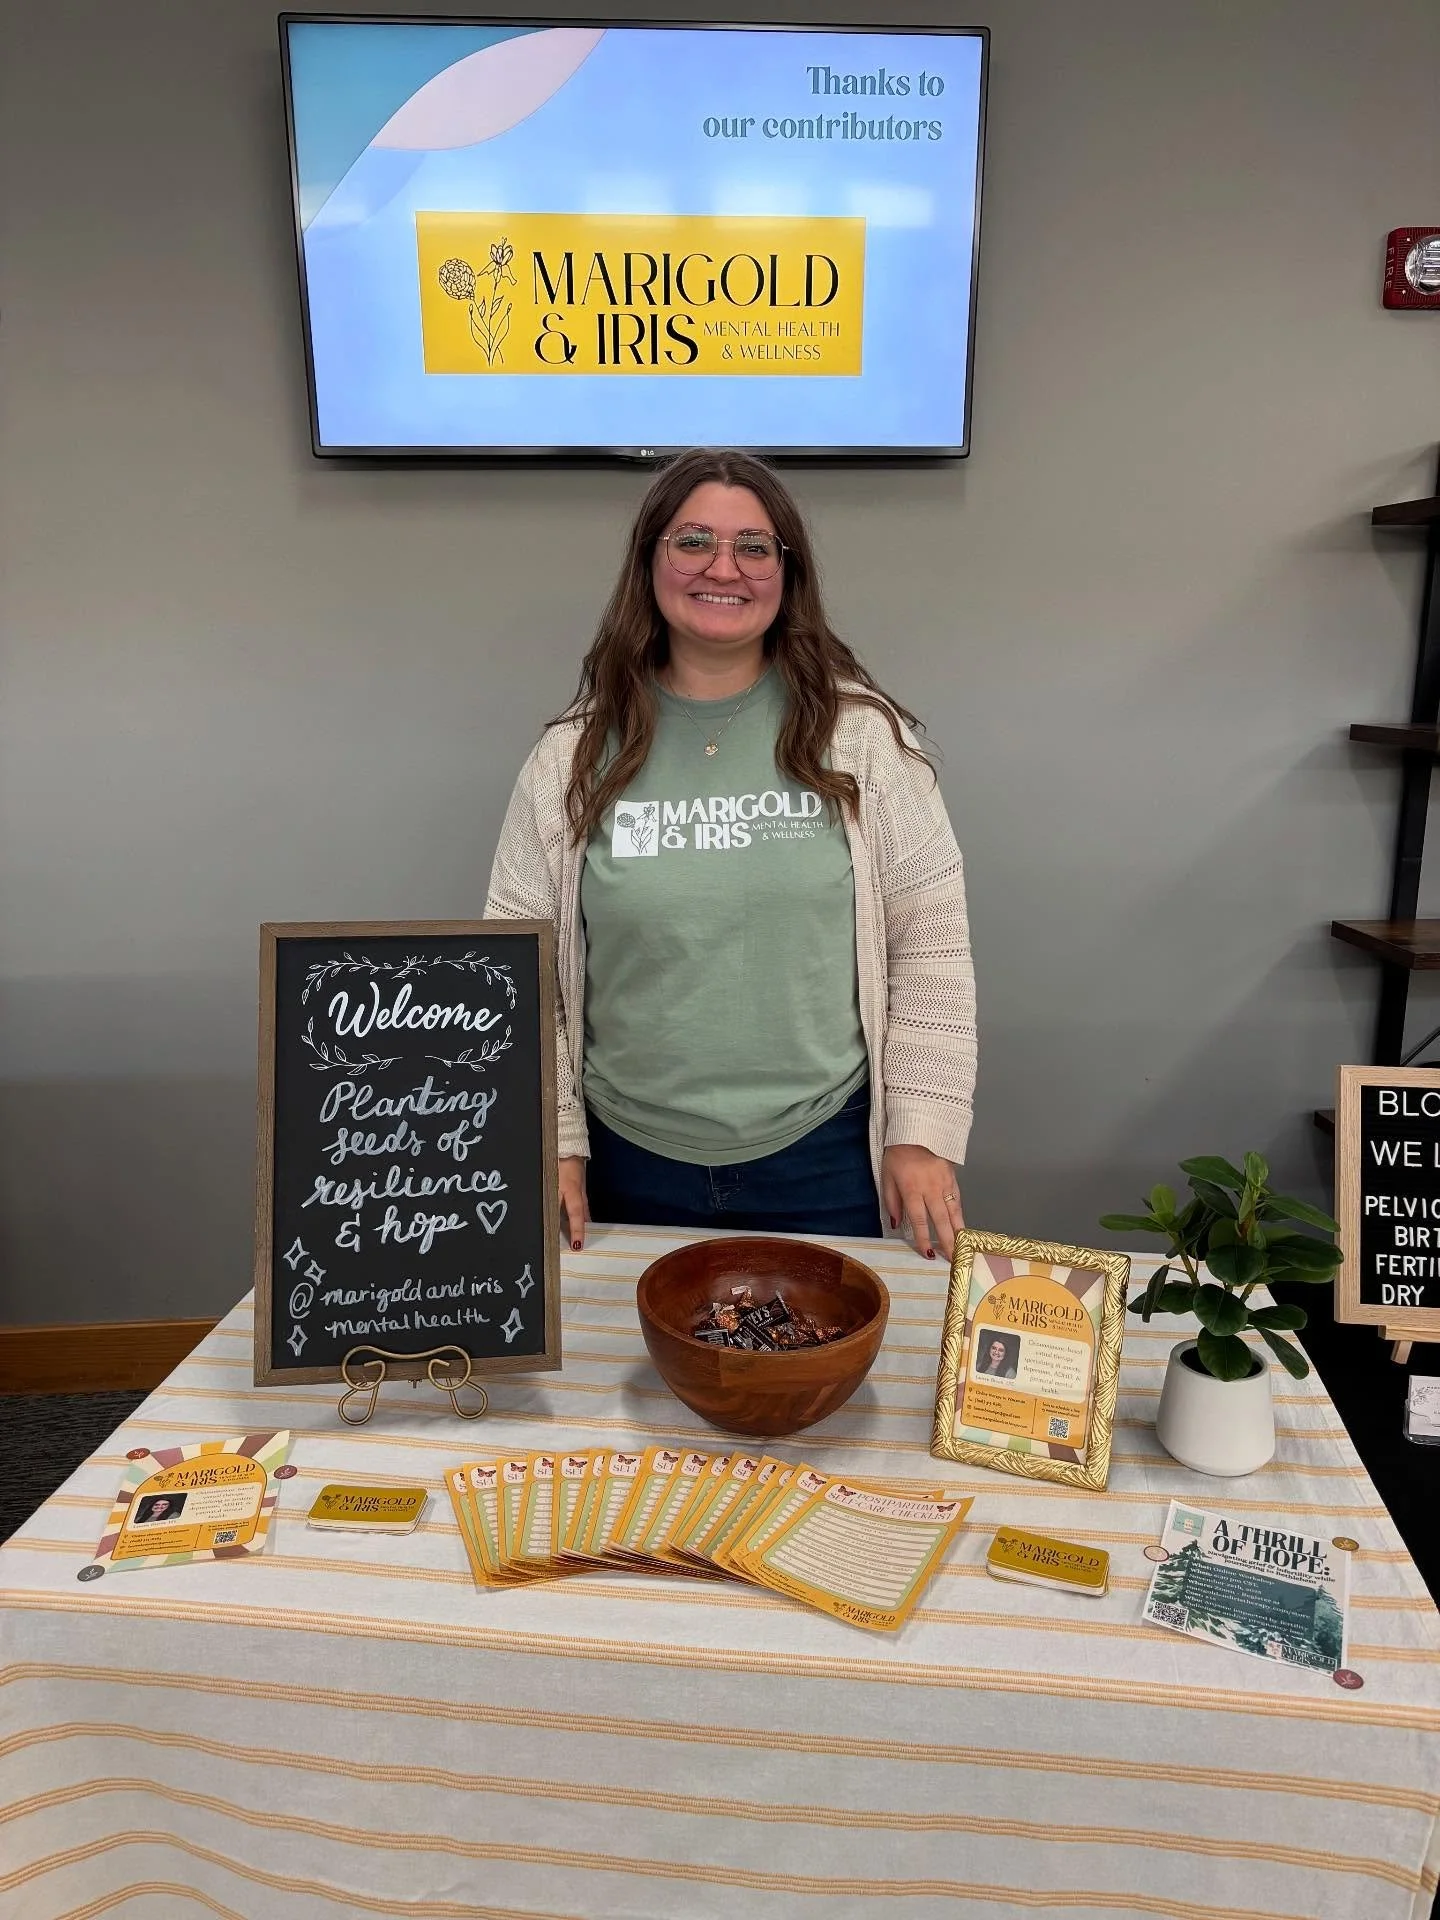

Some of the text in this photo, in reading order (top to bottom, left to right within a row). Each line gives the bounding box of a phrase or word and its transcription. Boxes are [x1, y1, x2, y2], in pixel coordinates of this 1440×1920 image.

[807, 66, 945, 97] Thanks to
[702, 112, 943, 141] our contributors
[532, 251, 839, 307] MARIGOLD
[1385, 247, 1395, 289] FIRE
[535, 313, 699, 365] & IRIS
[704, 321, 841, 337] MENTAL HEALTH
[721, 344, 821, 360] & WELLNESS
[663, 791, 823, 825] MARIGOLD
[661, 822, 752, 850] & IRIS
[752, 820, 824, 832] MENTAL HEALTH
[762, 831, 816, 841] & WELLNESS
[328, 981, 503, 1038] Welcome
[320, 1075, 498, 1128] Planting
[321, 1119, 485, 1167] seeds of
[1370, 1140, 1423, 1167] WE
[301, 1166, 509, 1212] resilience
[335, 1204, 469, 1255] & hope
[1376, 1253, 1440, 1277] FERTI
[1381, 1283, 1425, 1306] DRY
[1007, 1310, 1018, 1323] &
[1022, 1312, 1048, 1328] IRIS
[1008, 1296, 1084, 1322] MARIGOLD
[176, 1463, 256, 1481] MARIGOLD
[190, 1475, 218, 1487] IRIS
[343, 1495, 417, 1506] MARIGOLD
[352, 1504, 379, 1512] IRIS
[857, 1492, 936, 1512] POSTPARTUM
[891, 1508, 952, 1521] CHECKLIST
[1213, 1519, 1229, 1537] A
[1238, 1524, 1328, 1559] THRILL
[1019, 1541, 1100, 1567] MARIGOLD
[1032, 1552, 1060, 1567] IRIS
[1207, 1550, 1248, 1564] Navigating
[1248, 1558, 1267, 1567] grief
[1276, 1567, 1314, 1579] infertility
[1212, 1535, 1331, 1576] OF HOPE:
